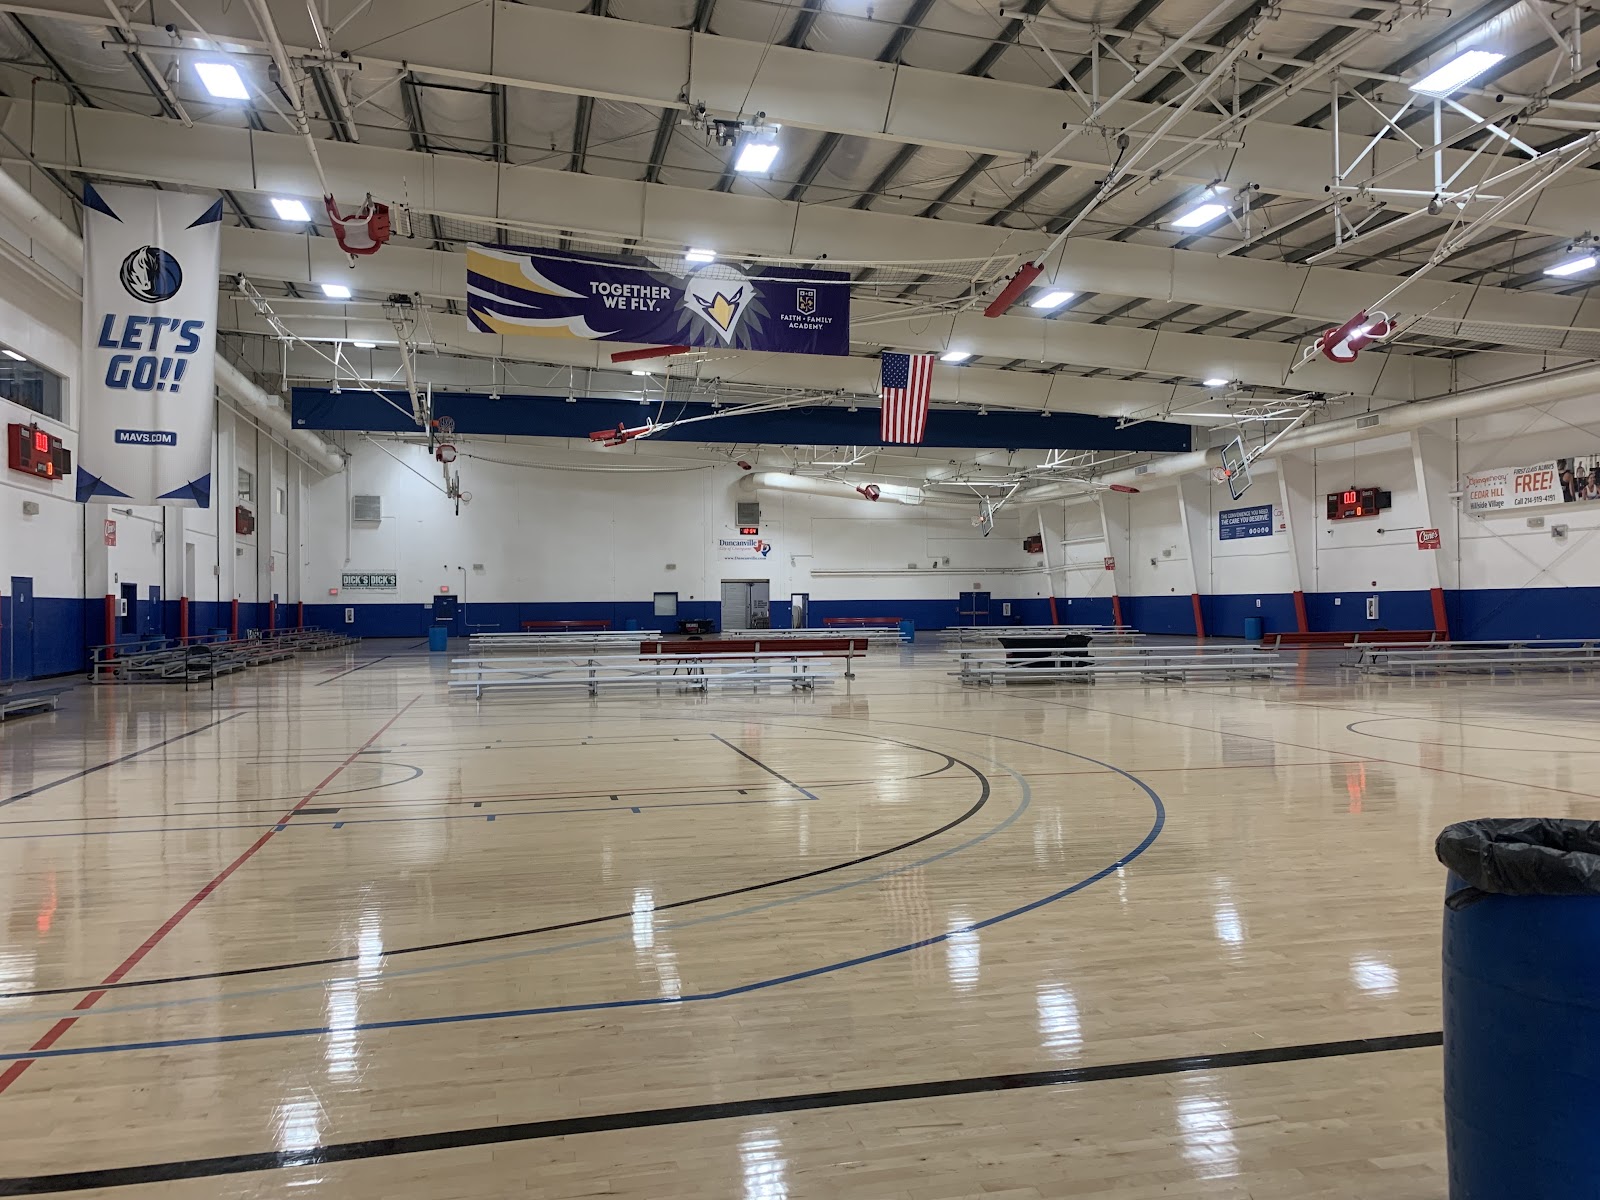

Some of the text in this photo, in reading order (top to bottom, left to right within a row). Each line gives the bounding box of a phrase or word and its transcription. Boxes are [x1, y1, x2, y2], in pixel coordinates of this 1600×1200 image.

[589, 281, 671, 300] TOGETHER
[603, 295, 661, 312] WE FLY.
[780, 314, 833, 324] FAITH FAMILY
[788, 322, 823, 330] ACADEMY
[98, 313, 205, 354] LET'S
[105, 354, 188, 393] GO!!
[119, 432, 173, 444] MAVS.COM
[47, 462, 52, 475] 0
[1515, 471, 1553, 493] FREE!
[1471, 488, 1504, 499] CEDAR HILL
[1471, 500, 1504, 509] Hillside Village
[1357, 507, 1361, 516] 0
[1419, 530, 1438, 543] Cane's
[344, 576, 396, 584] DICK'S DICK'S
